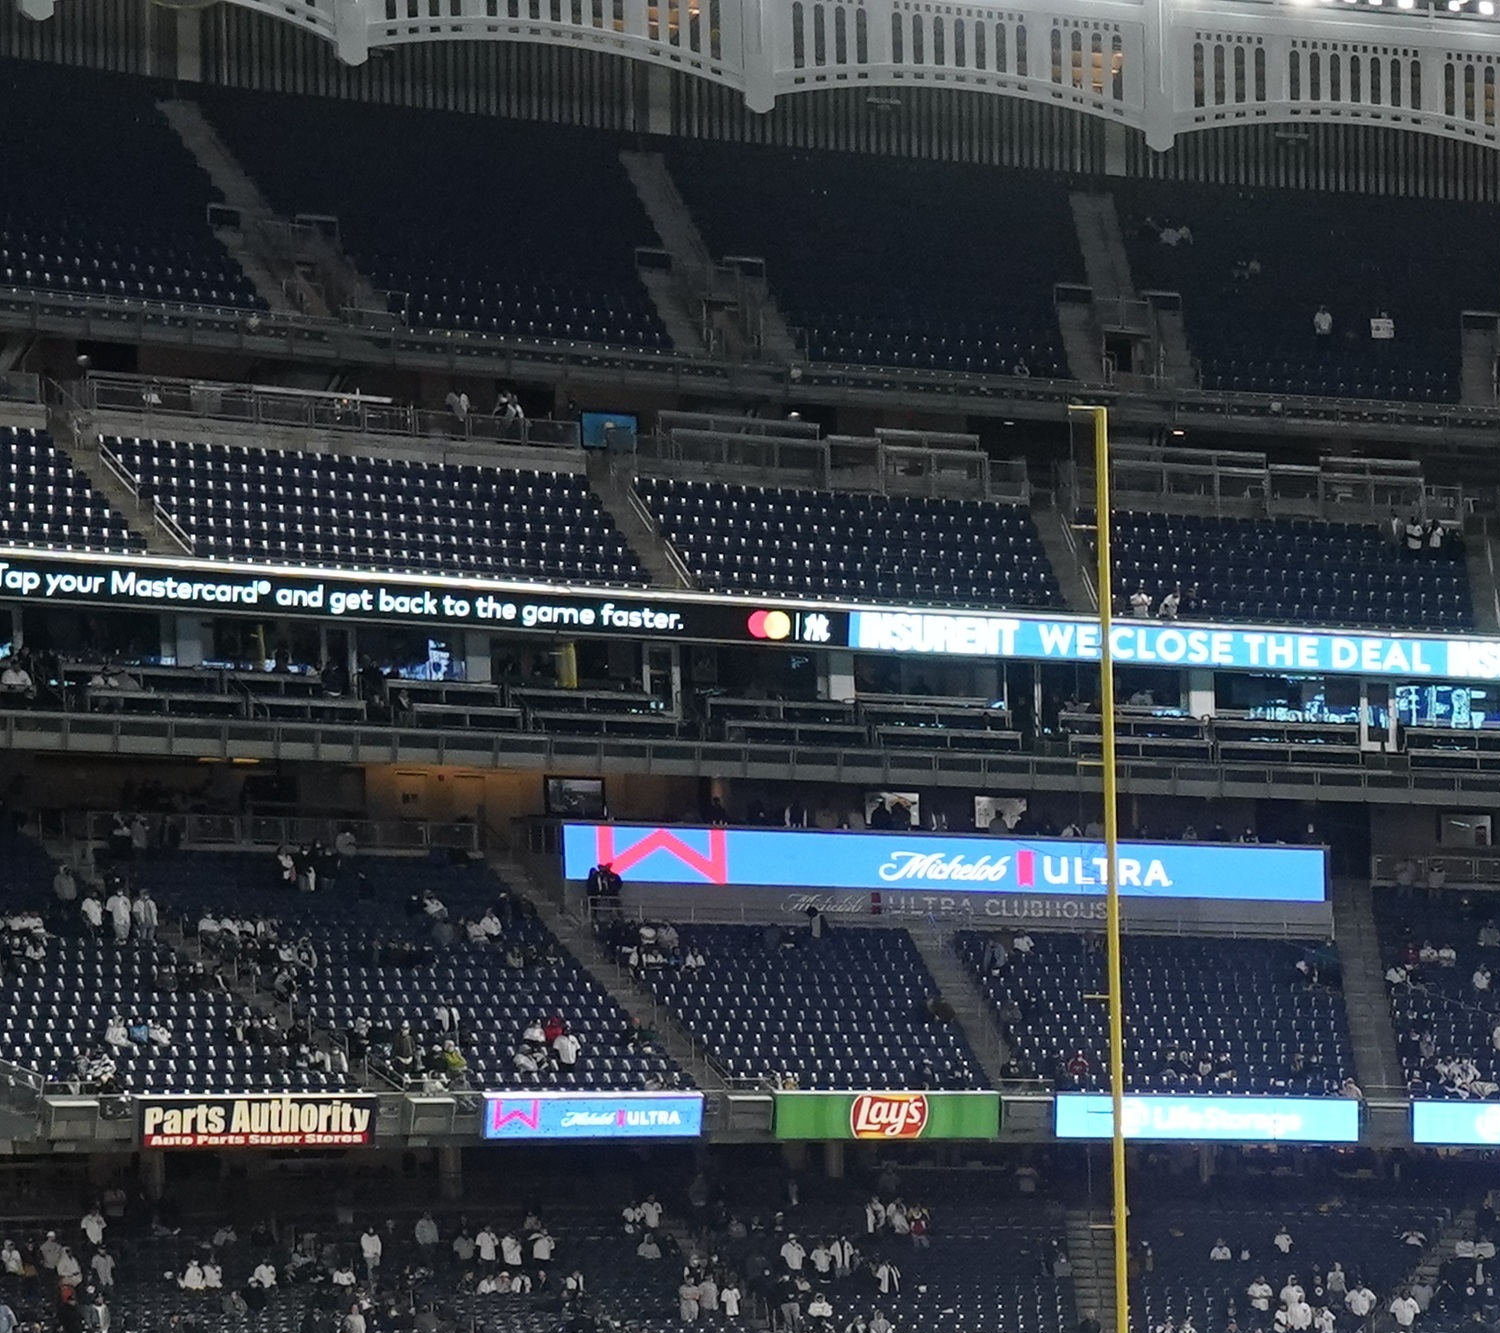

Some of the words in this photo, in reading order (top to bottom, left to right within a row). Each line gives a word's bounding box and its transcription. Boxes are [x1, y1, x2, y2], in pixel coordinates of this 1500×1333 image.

[0, 563, 40, 593] Tap
[46, 574, 105, 597] your
[276, 585, 324, 608] and
[331, 589, 373, 613] get
[379, 588, 437, 616] back
[442, 596, 470, 618] to
[477, 596, 517, 620] the
[522, 605, 595, 627] game
[601, 603, 684, 631] faster.
[1038, 622, 1099, 657] WE
[1109, 626, 1233, 664] CLOSE
[1244, 632, 1319, 667] THE
[1331, 637, 1431, 674] DEAL
[879, 851, 1011, 882] Michelob
[1043, 855, 1173, 888] ULTRA
[144, 1105, 225, 1136] Parts
[230, 1099, 371, 1135] Authority
[627, 1111, 681, 1126] ULTRA
[856, 1096, 923, 1136] Lay's
[150, 1134, 194, 1146] Auto
[196, 1135, 246, 1145] Parts
[249, 1134, 303, 1146] Super
[304, 1133, 363, 1145] Stores
